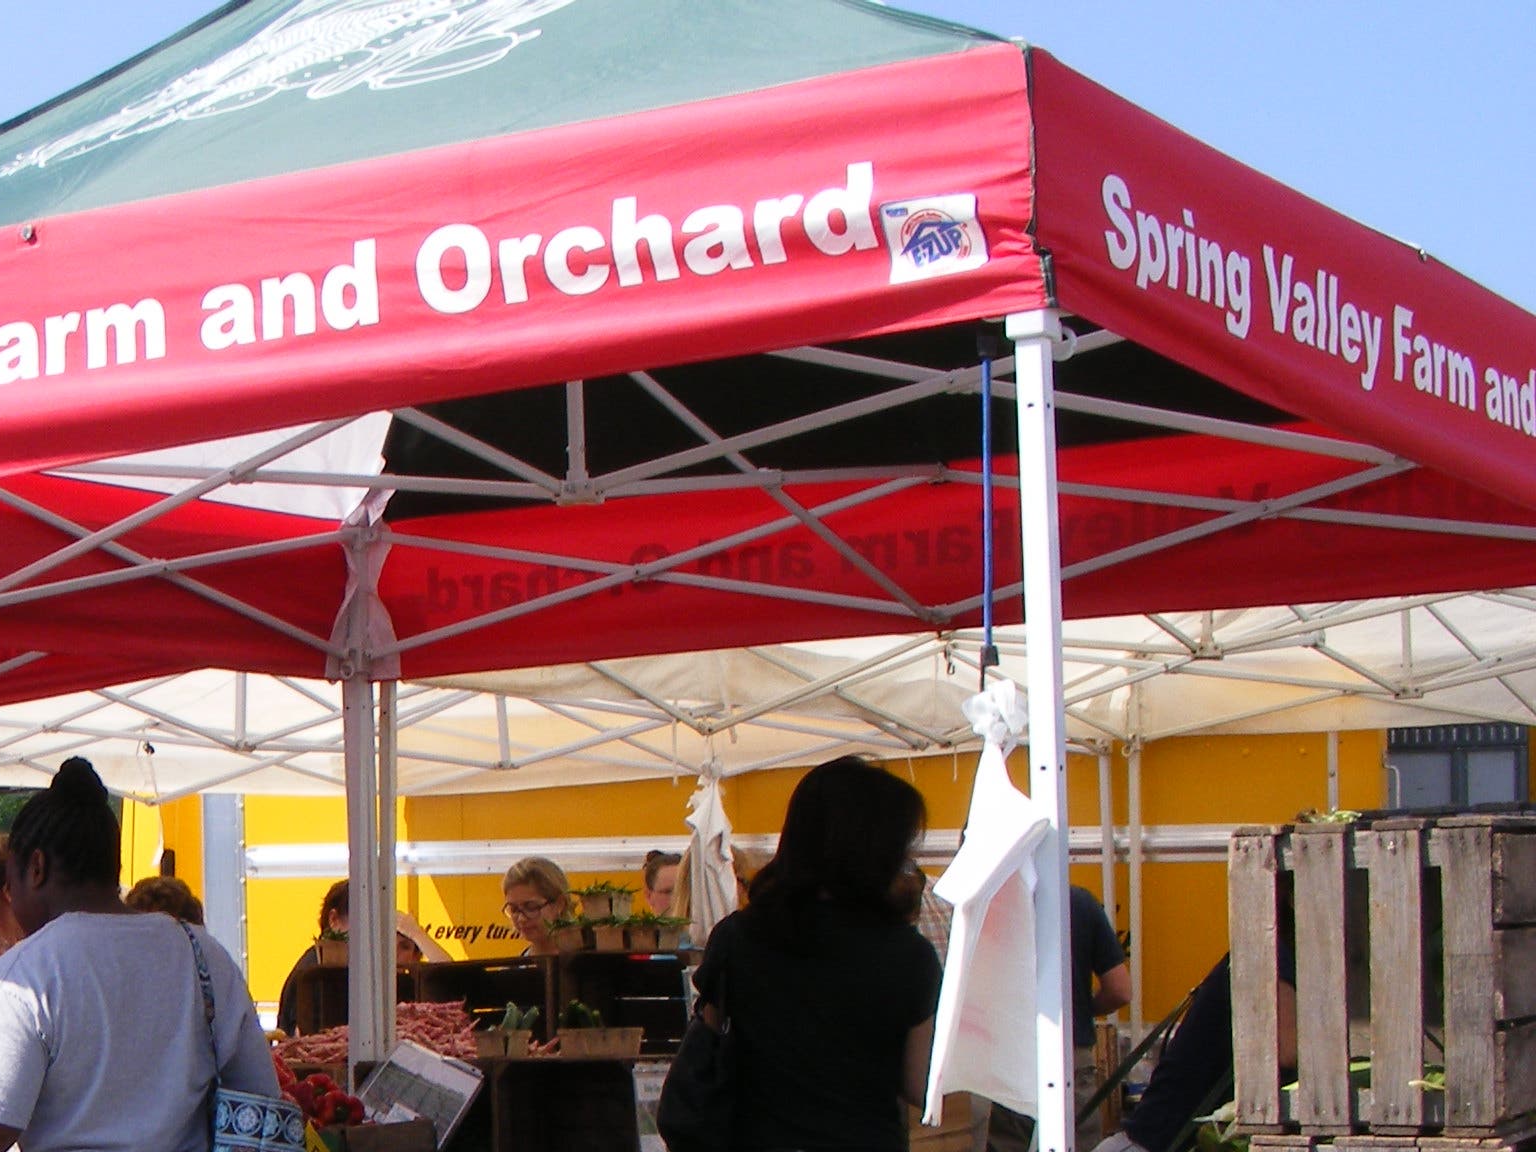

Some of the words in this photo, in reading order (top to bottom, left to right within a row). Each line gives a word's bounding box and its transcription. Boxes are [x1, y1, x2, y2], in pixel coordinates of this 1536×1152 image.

[201, 239, 380, 351] and
[416, 161, 874, 314] Orchard
[1102, 174, 1251, 340] Spring
[1263, 245, 1382, 391] Valley
[1393, 304, 1476, 411] Farm
[1485, 368, 1536, 438] and
[434, 924, 482, 943] every
